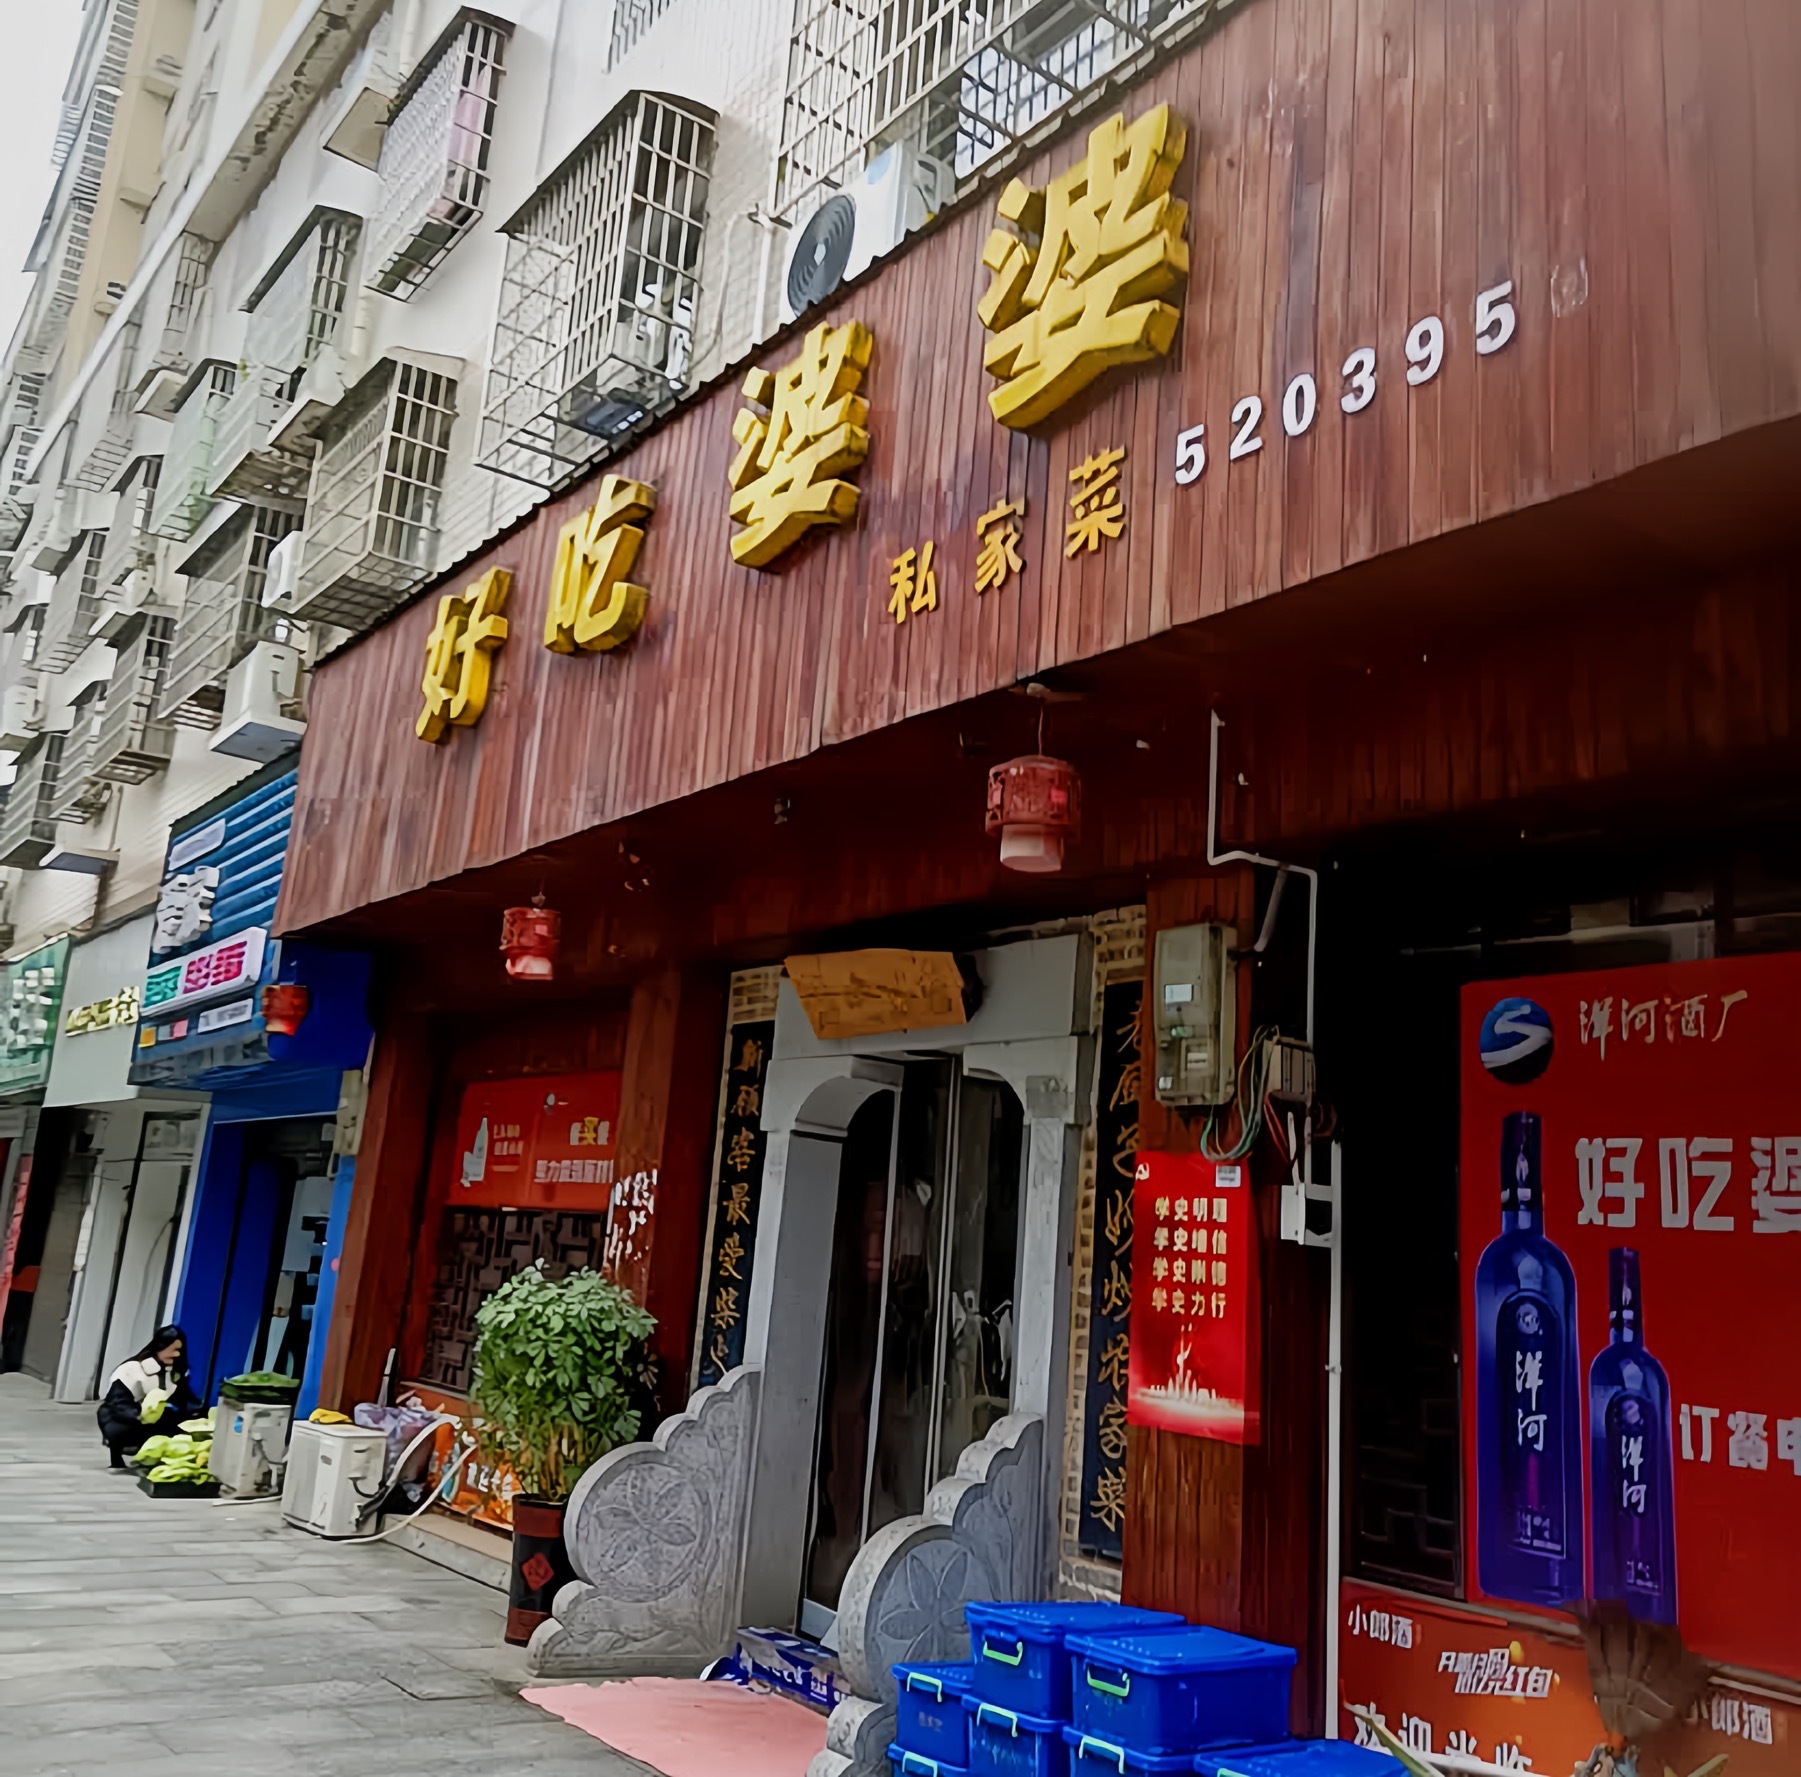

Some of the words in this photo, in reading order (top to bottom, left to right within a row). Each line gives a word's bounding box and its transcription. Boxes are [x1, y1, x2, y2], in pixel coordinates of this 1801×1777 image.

[415, 103, 1190, 743] 好吃婆婆
[1174, 280, 1516, 485] 520395
[887, 445, 1127, 624] 私家菜
[1579, 989, 1748, 1062] 洋河酒厂
[1515, 1350, 1547, 1452] 洋河
[1620, 1434, 1647, 1513] 洋河
